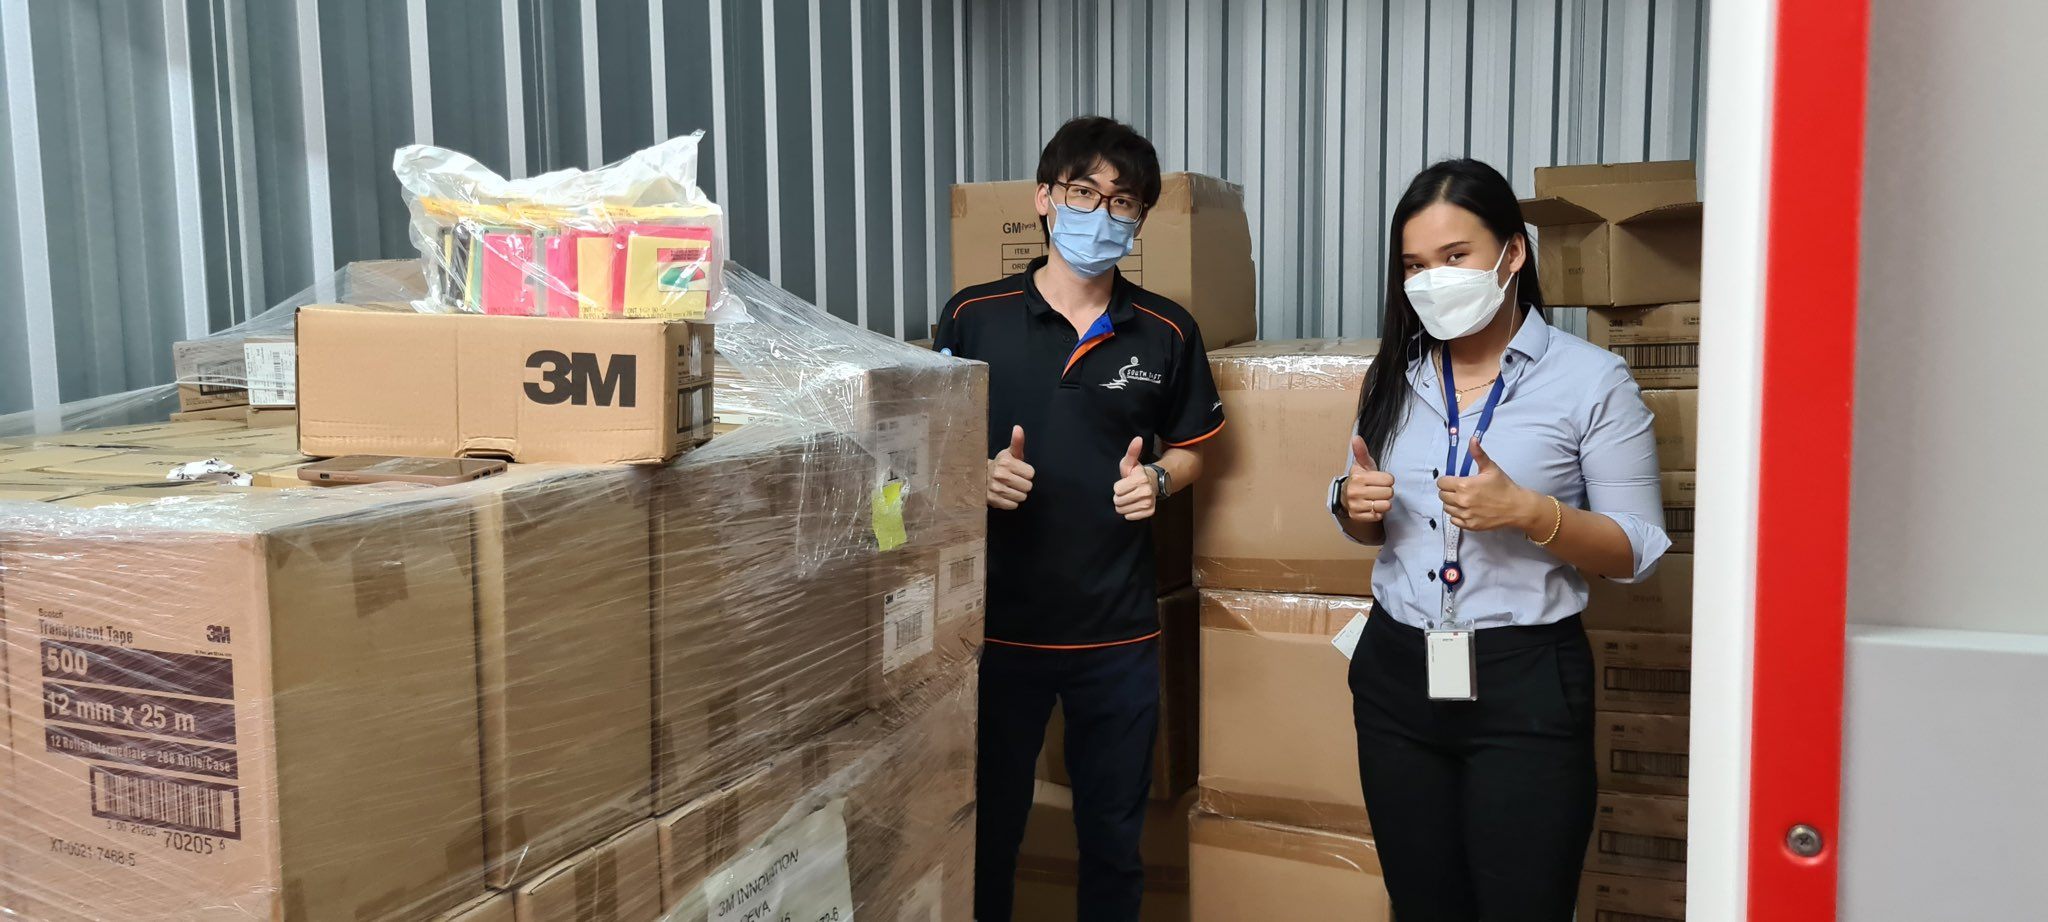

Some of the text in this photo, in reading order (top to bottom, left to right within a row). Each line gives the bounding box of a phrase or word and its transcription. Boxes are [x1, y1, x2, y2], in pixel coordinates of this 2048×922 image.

[523, 349, 637, 408] 3M
[1127, 369, 1148, 377] SOUTH
[38, 607, 64, 619] Scotch
[38, 618, 134, 646] Transparent Tape
[206, 624, 231, 644] 3M
[46, 647, 88, 676] 500
[48, 691, 196, 732] 12 mm x 25 m
[50, 734, 62, 748] 12
[177, 753, 231, 772] Rolls/Case
[163, 831, 213, 855] 70205
[718, 849, 799, 917] 3M INNOVATION
